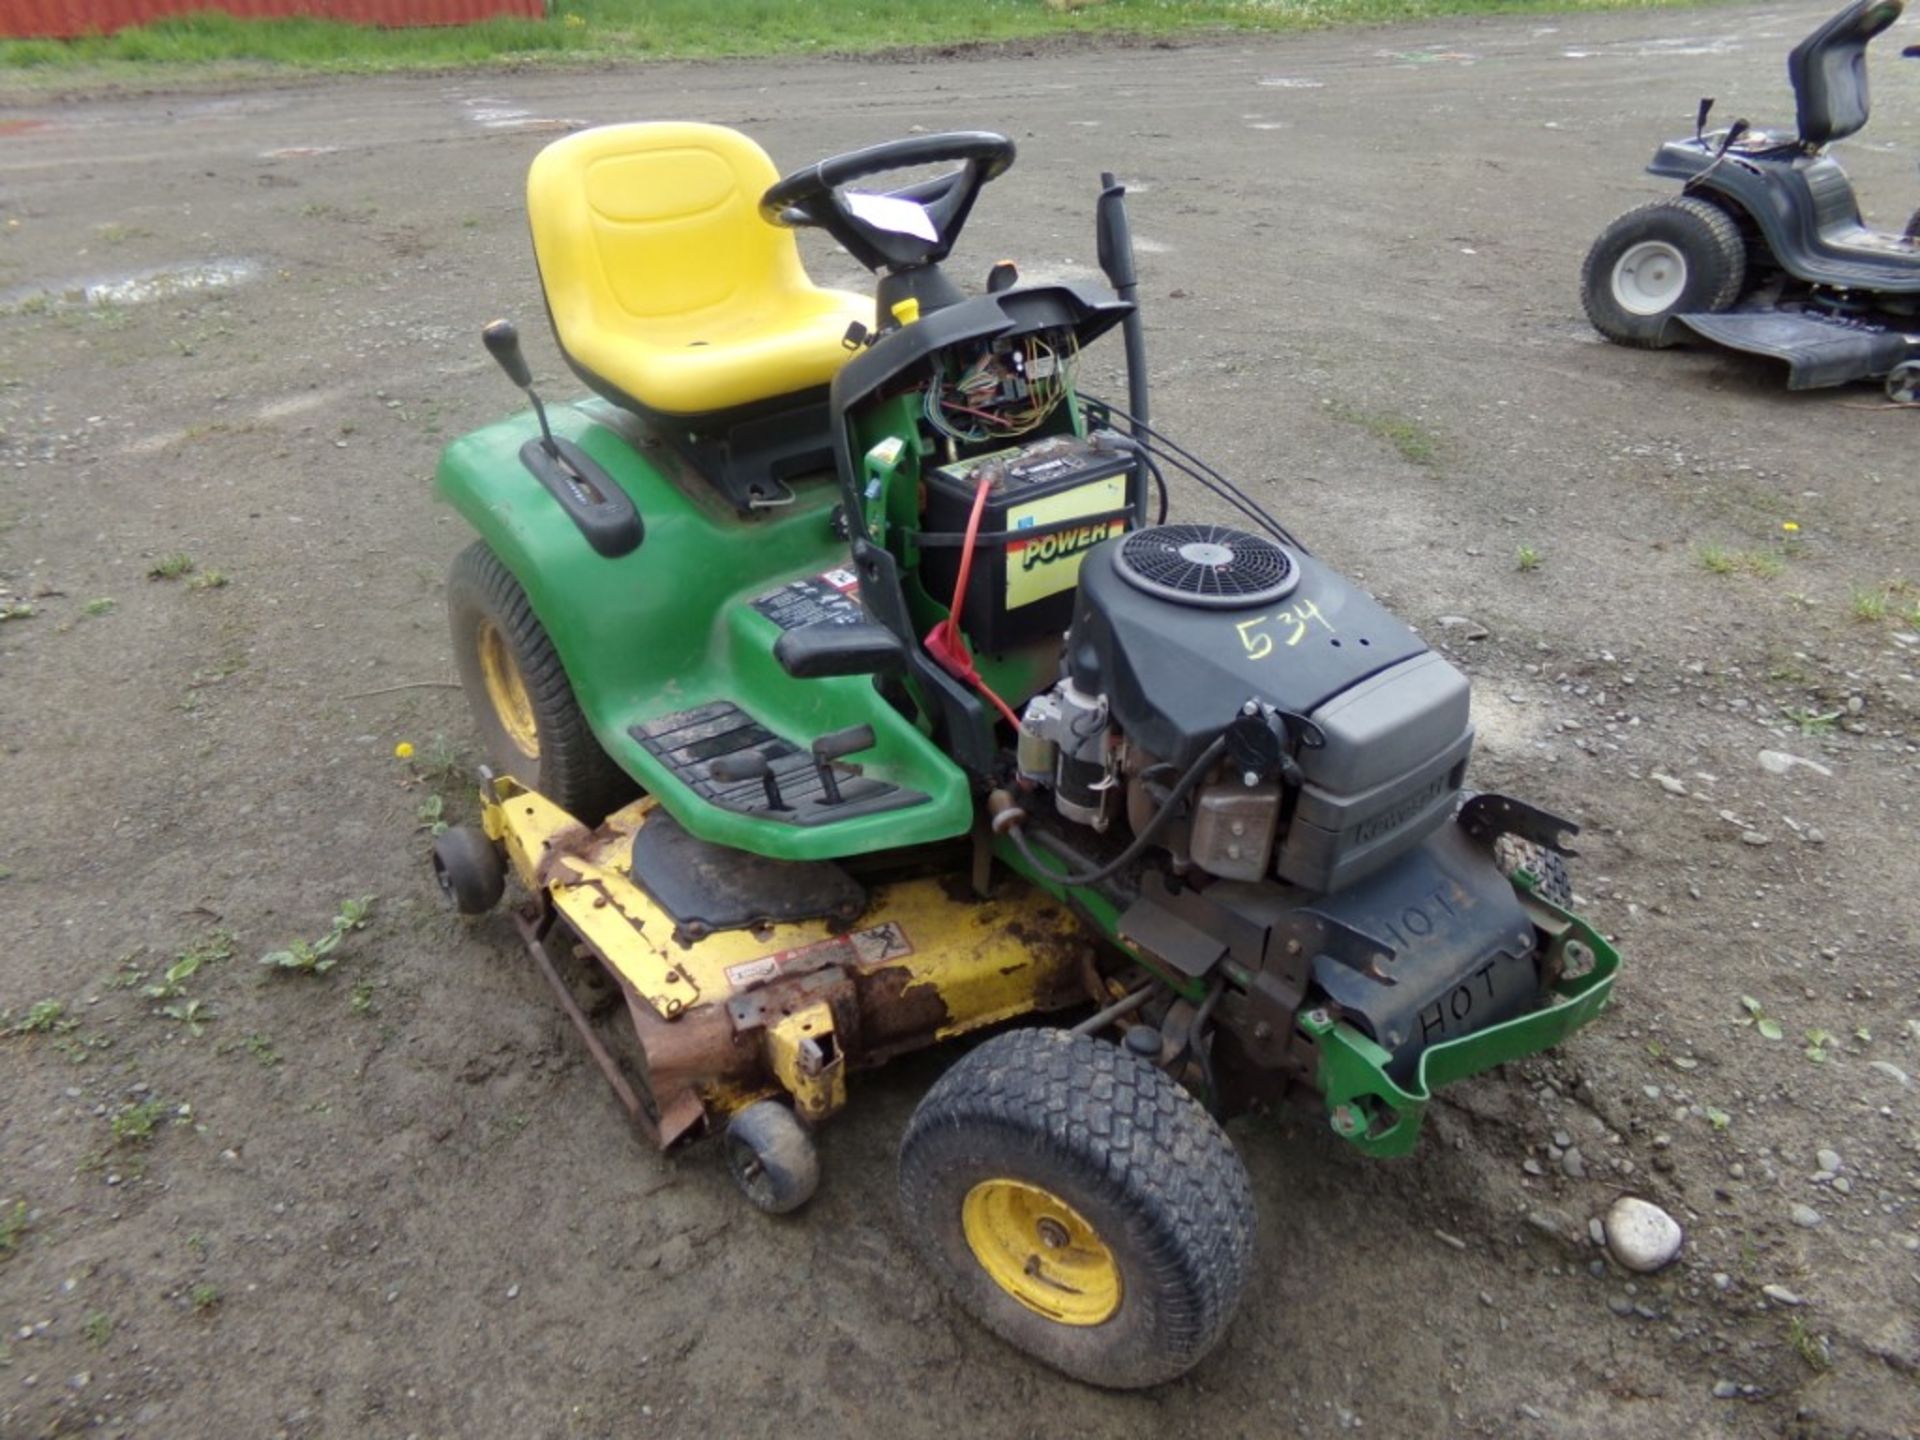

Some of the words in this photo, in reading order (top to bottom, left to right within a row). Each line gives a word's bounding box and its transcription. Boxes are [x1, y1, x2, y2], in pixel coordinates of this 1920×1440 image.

[1022, 522, 1109, 570] POWER
[1235, 599, 1336, 660] 534
[1419, 960, 1496, 1044] HOT
